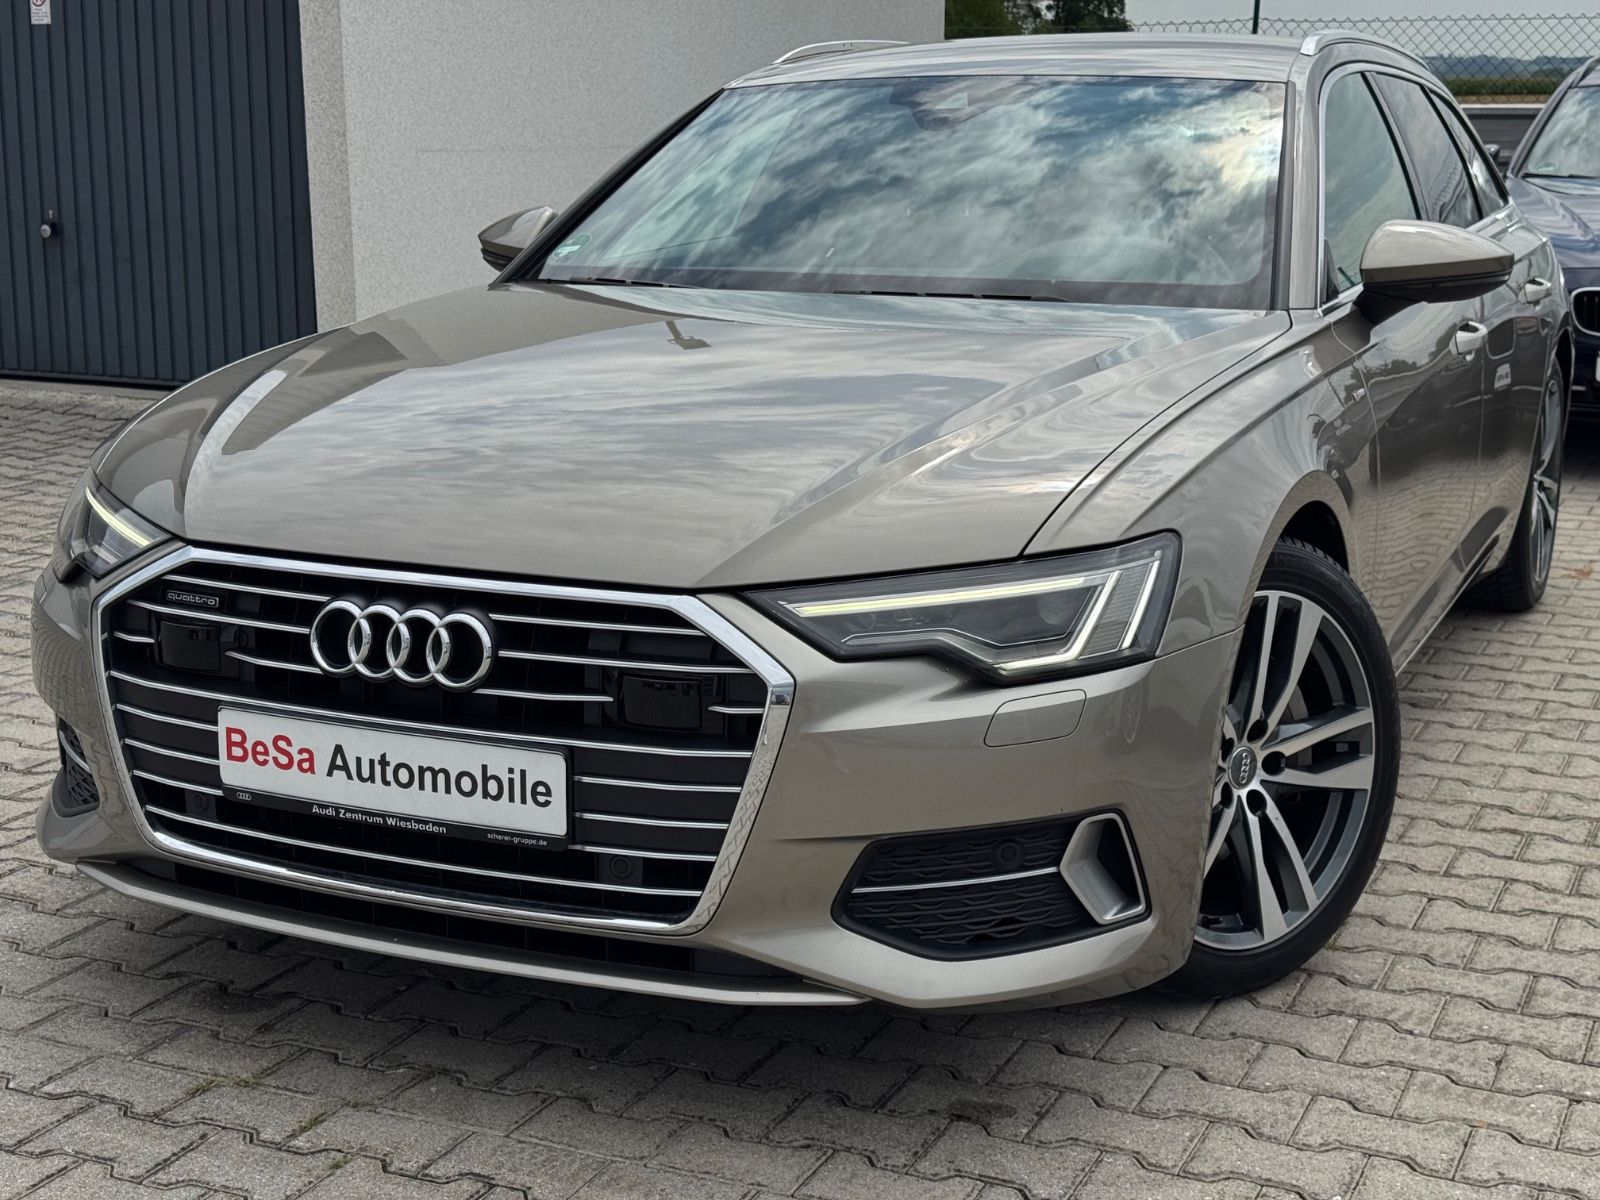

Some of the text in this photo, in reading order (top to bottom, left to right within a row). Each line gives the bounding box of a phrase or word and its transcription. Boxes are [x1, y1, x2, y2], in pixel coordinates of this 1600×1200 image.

[167, 592, 216, 606] quattro
[225, 726, 553, 809] BeSa Automobile
[311, 804, 447, 835] Audi Zentrum Wiesbaden
[486, 832, 548, 847] scherer-gruppe.de
